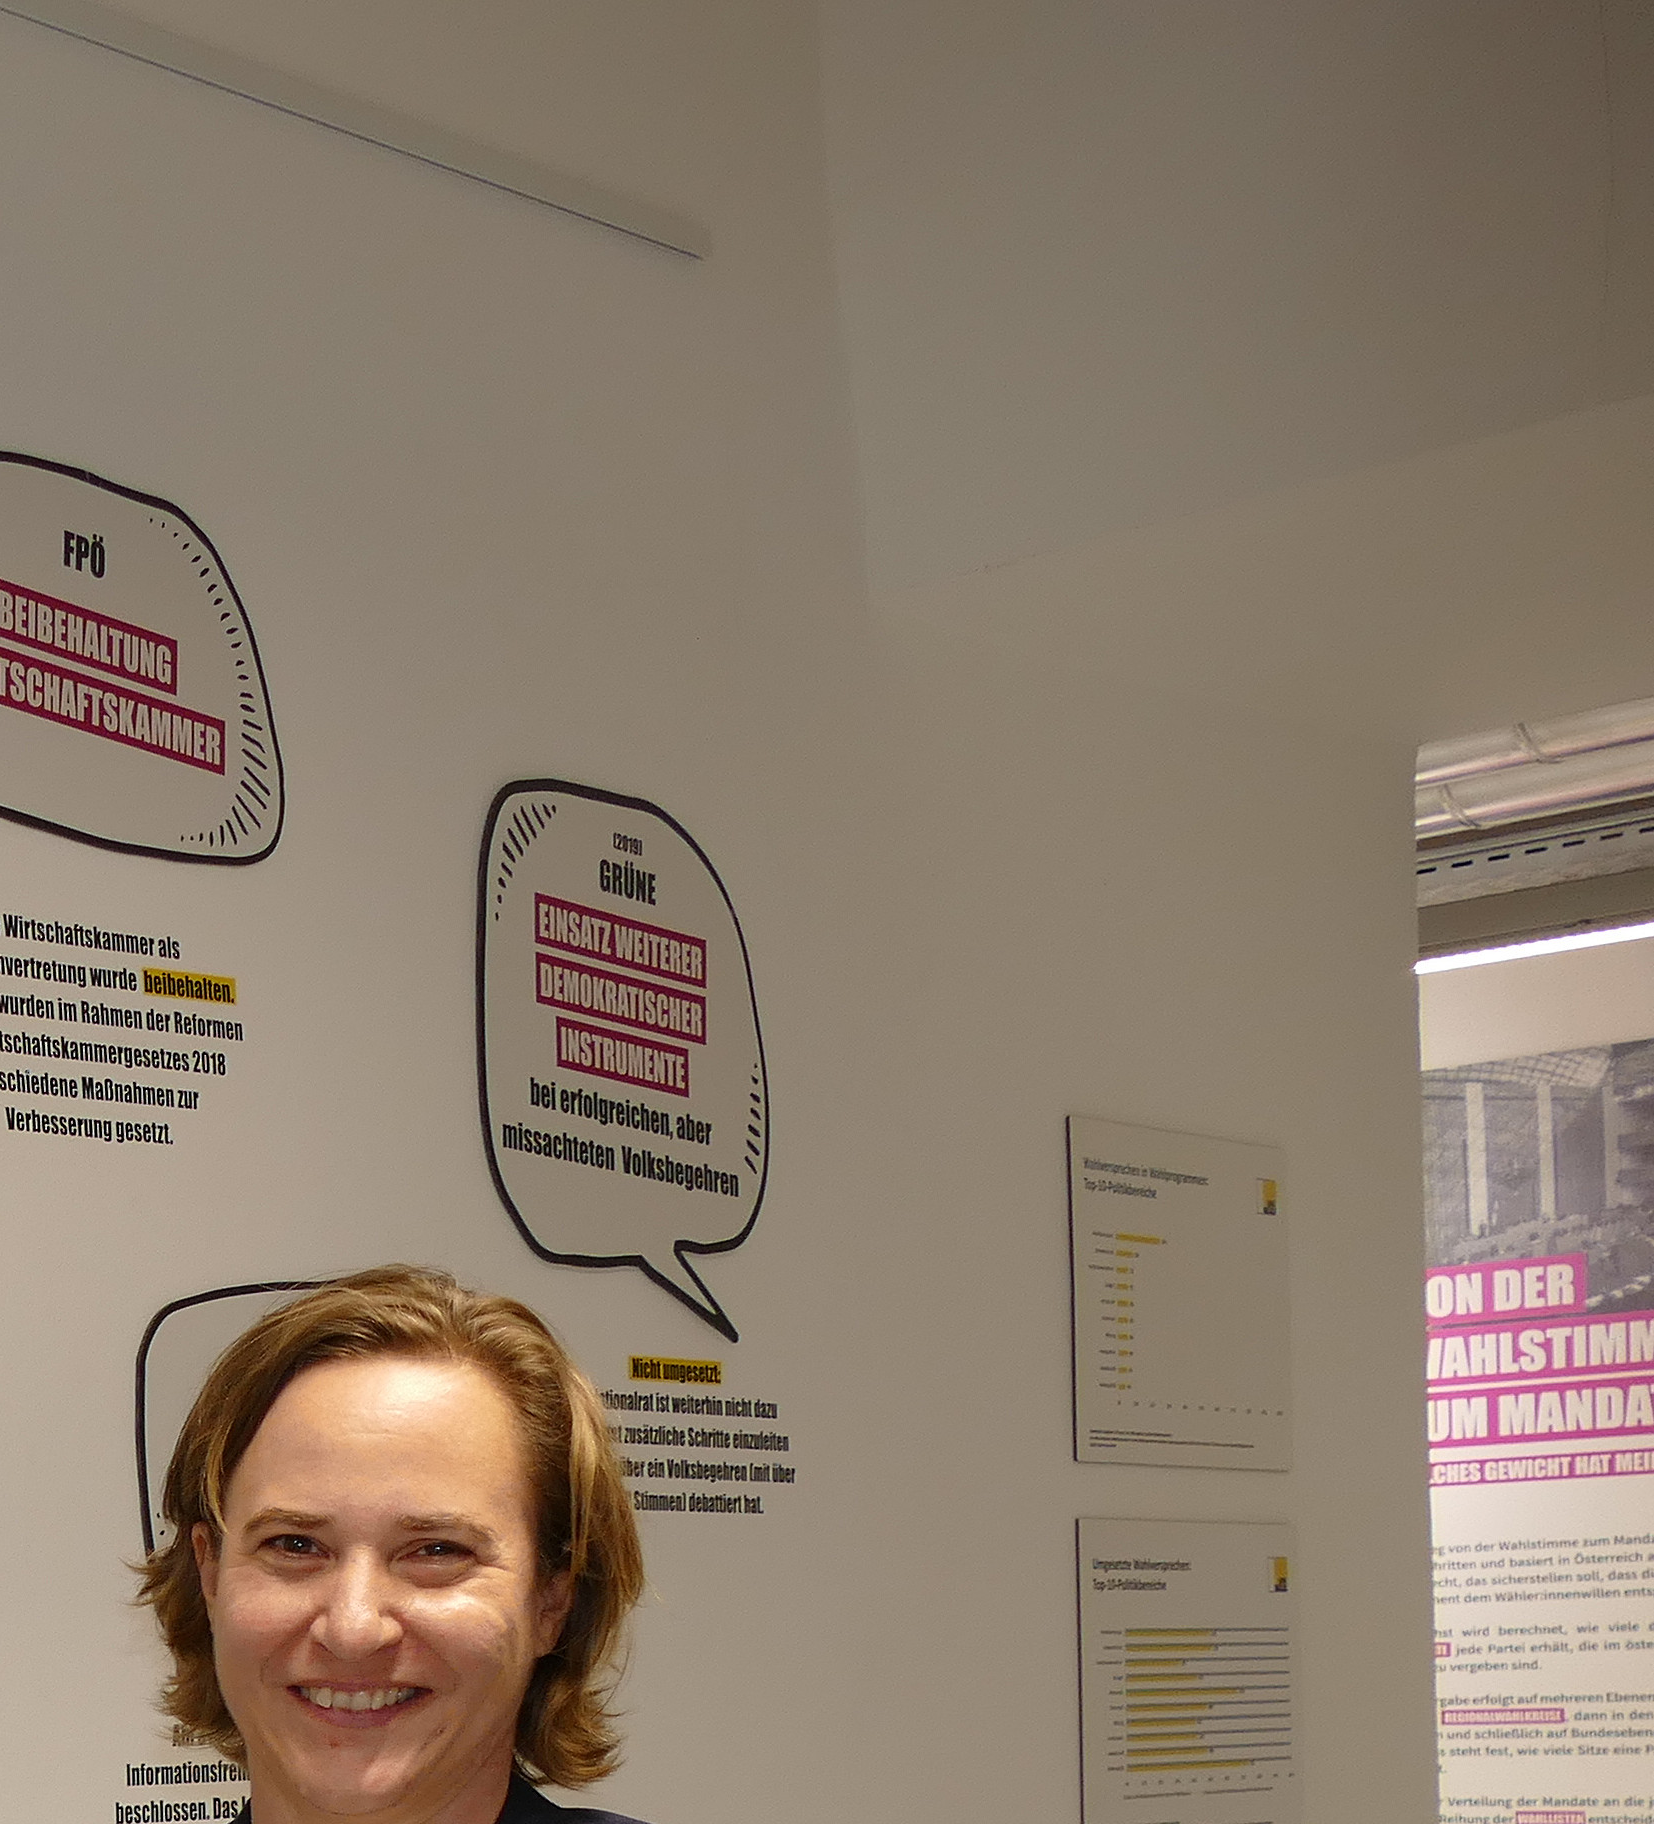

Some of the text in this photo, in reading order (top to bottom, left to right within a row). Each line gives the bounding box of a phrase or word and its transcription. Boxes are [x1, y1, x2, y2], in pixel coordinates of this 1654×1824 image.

[64, 530, 105, 578] FPÖ
[600, 859, 656, 905] GRÜNE
[3, 914, 154, 956] Wirtschaftskammer
[158, 936, 180, 959] als
[539, 903, 702, 979] EINSATZ WEITERER
[90, 968, 137, 991] wurde
[144, 970, 234, 1003] beibehalten.
[540, 963, 702, 1036] DEMOKRATISCHER
[192, 1050, 225, 1075] 2018
[561, 1027, 691, 1092] INSTRUMENTE
[82, 1077, 174, 1107] Maßnahmen
[178, 1090, 198, 1109] zur
[530, 1077, 711, 1145] bei erfolgreichen, aber
[5, 1107, 173, 1144] Verbesserung gesetzt.
[503, 1124, 738, 1197] missachteten Volksbegehren
[1493, 1264, 1575, 1311] DER
[632, 1358, 721, 1383] Nicht umgesetzt:
[1499, 1383, 1654, 1436] MANDA
[1430, 1462, 1481, 1484] CHES
[1485, 1456, 1572, 1480] GEWICHT
[115, 1797, 239, 1824] beschlossen. Das
